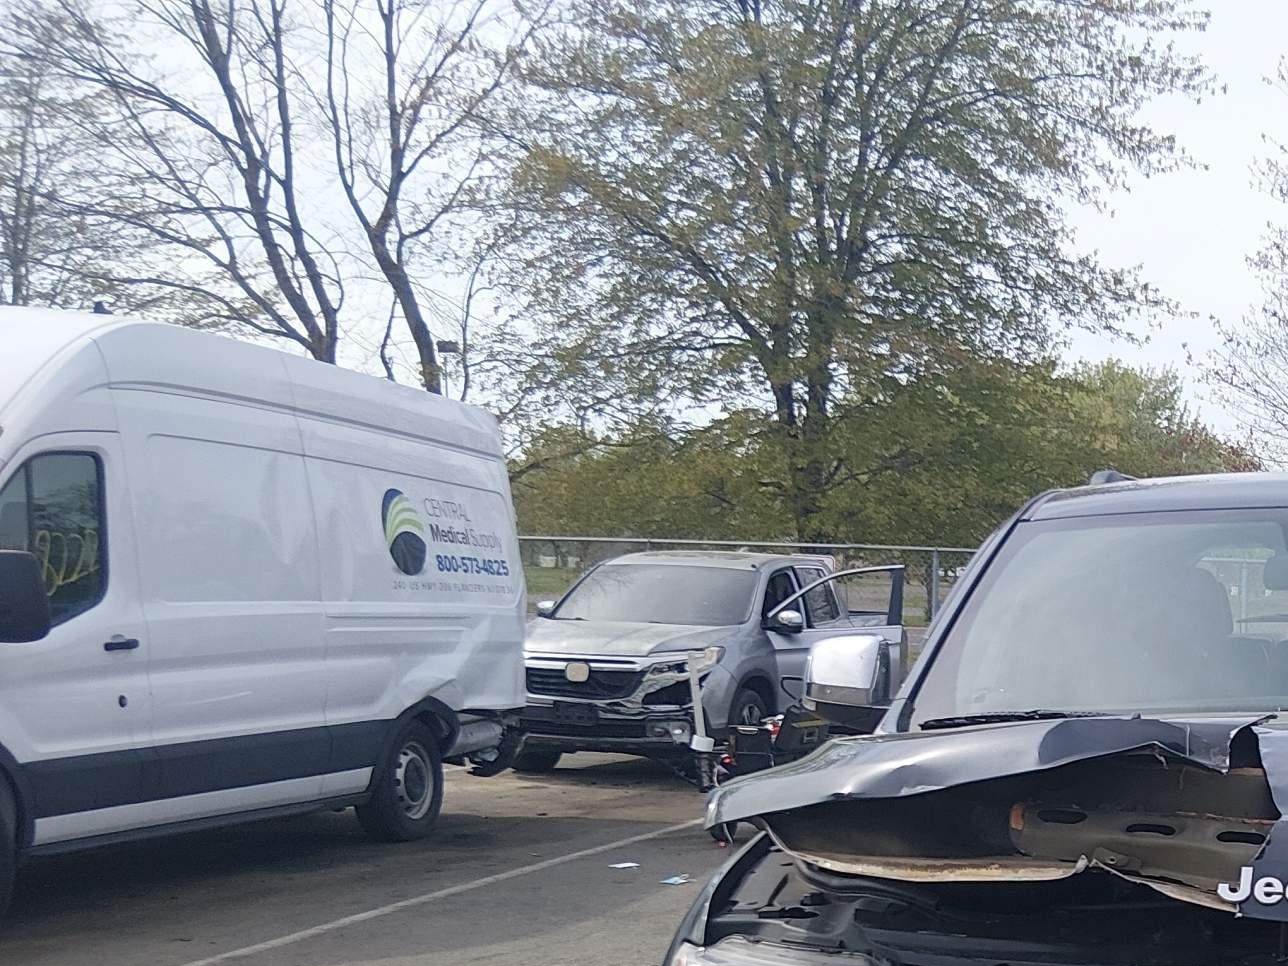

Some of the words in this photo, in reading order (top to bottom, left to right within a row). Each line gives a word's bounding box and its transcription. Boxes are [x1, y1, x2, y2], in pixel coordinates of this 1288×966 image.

[424, 498, 471, 522] CENTRAL
[429, 523, 470, 546] Medical
[436, 554, 509, 577] 800-573-4825
